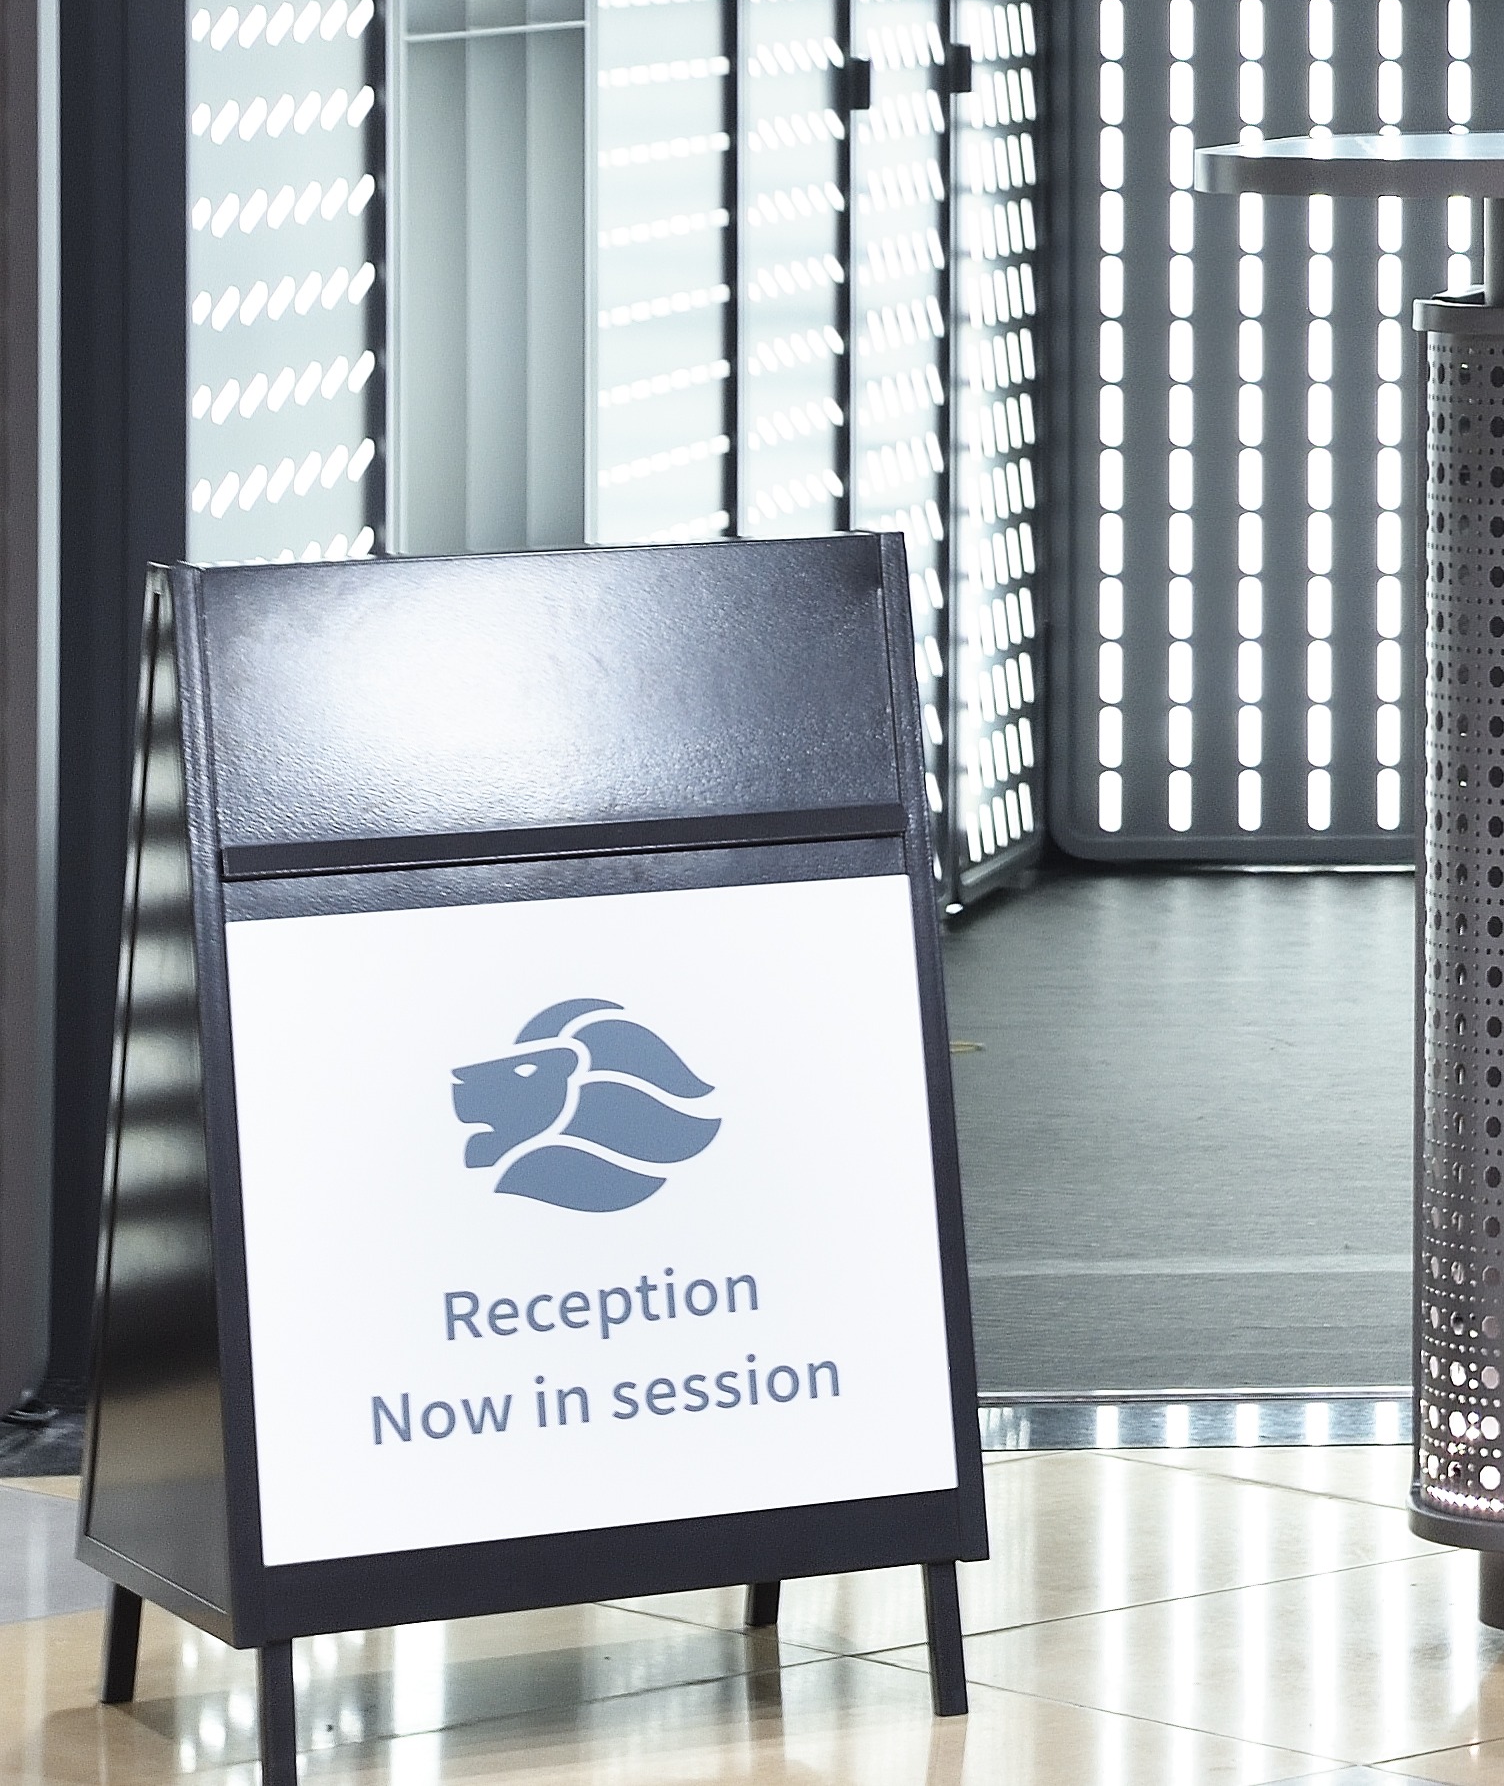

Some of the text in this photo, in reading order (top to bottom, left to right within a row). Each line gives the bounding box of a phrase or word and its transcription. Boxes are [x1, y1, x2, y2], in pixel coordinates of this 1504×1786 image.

[444, 1266, 759, 1340] Reception
[371, 1353, 840, 1446] Now in session
